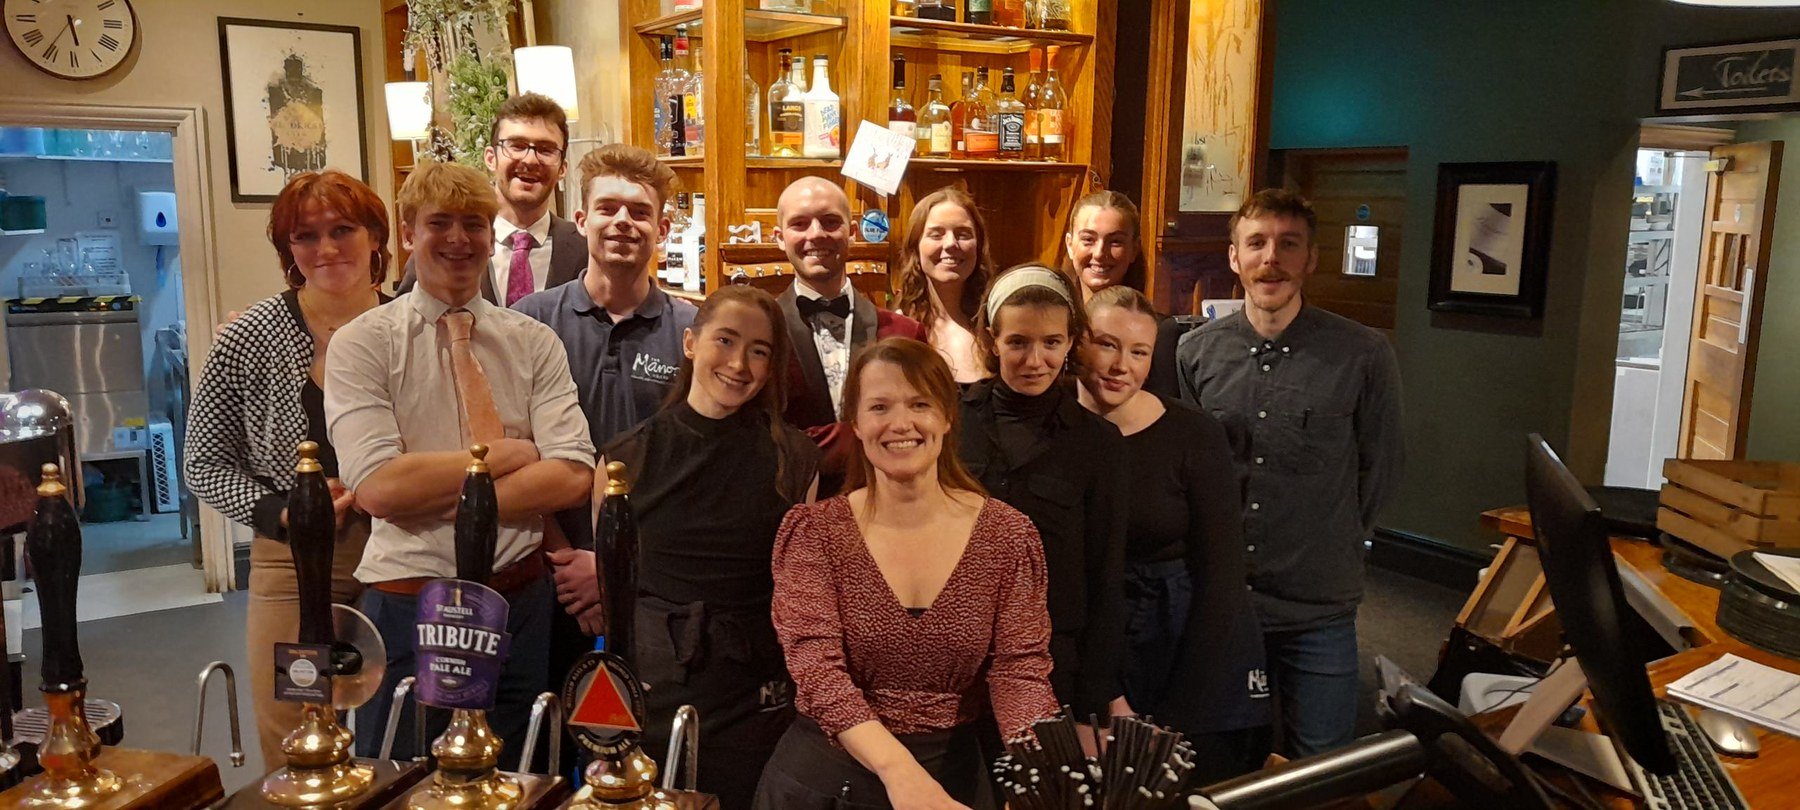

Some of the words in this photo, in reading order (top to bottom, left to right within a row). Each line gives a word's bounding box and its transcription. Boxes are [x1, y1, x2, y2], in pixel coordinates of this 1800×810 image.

[417, 624, 501, 655] TRIBUTE
[429, 662, 450, 673] PALE
[452, 665, 472, 676] ALE
